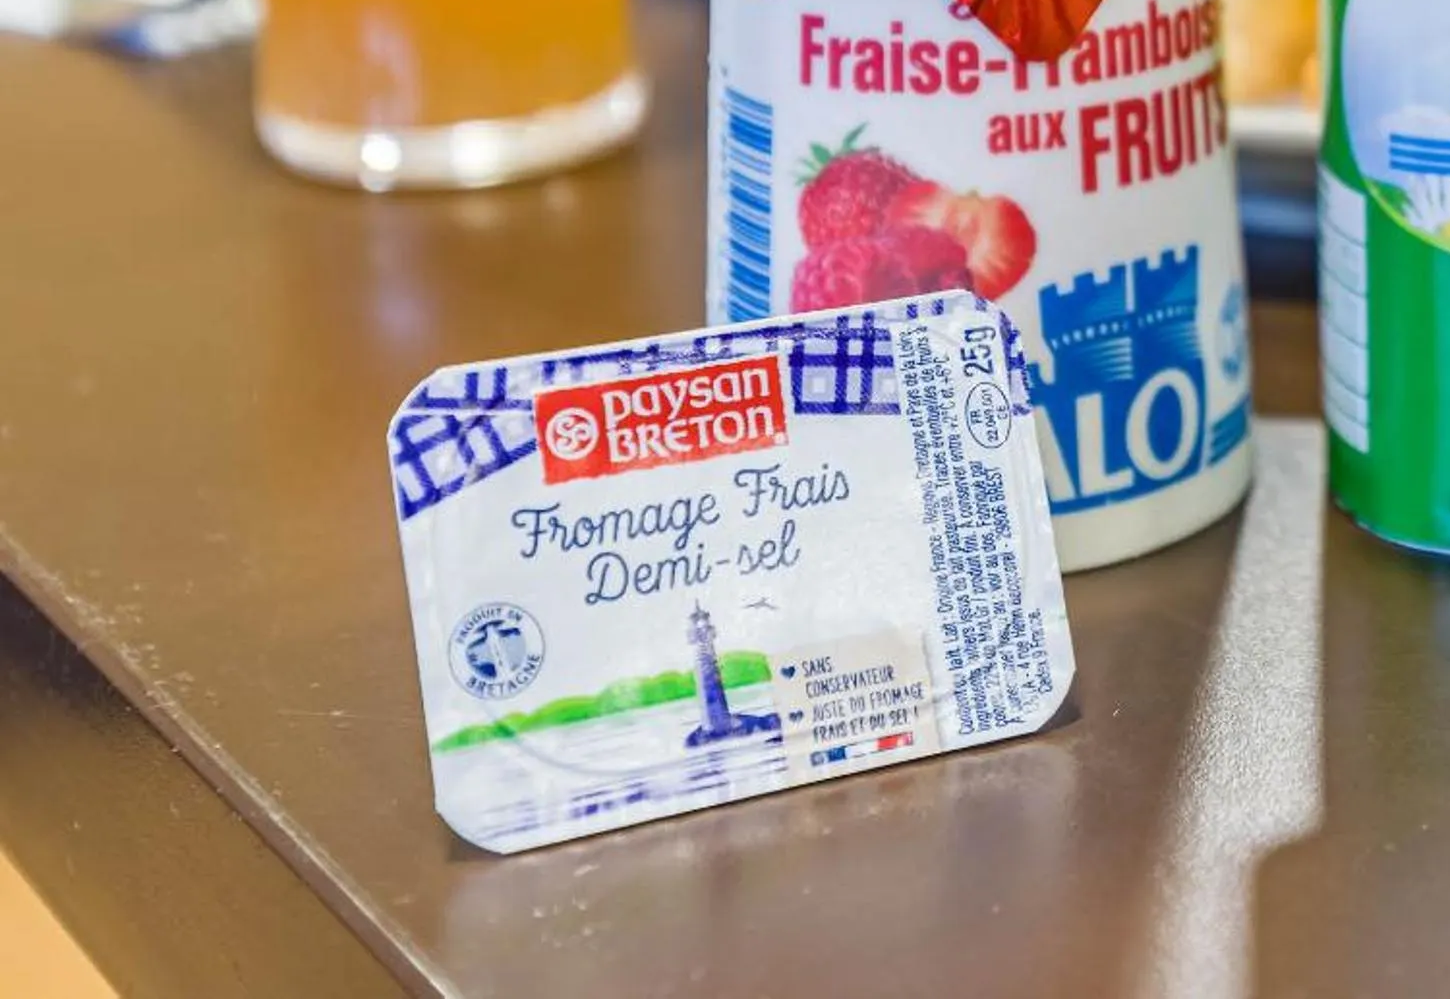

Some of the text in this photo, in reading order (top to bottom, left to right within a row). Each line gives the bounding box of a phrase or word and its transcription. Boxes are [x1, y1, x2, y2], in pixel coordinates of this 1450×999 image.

[988, 110, 1066, 154] aux
[960, 326, 997, 377] 25g
[602, 367, 771, 428] paysan
[904, 374, 916, 386] de
[905, 389, 922, 415] Pays
[971, 409, 981, 424] FR
[606, 404, 776, 464] BRETON
[948, 433, 962, 461] entre
[931, 451, 949, 488] Traces
[986, 467, 1003, 501] BREST
[953, 465, 971, 517] conserver
[511, 463, 851, 560] Fromage Frais
[585, 521, 801, 606] Demi-sel
[466, 654, 541, 696] BRETAGNE
[801, 656, 833, 678] SANS
[805, 664, 895, 699] CONSERVATEUR
[869, 681, 925, 711] FROMAGE
